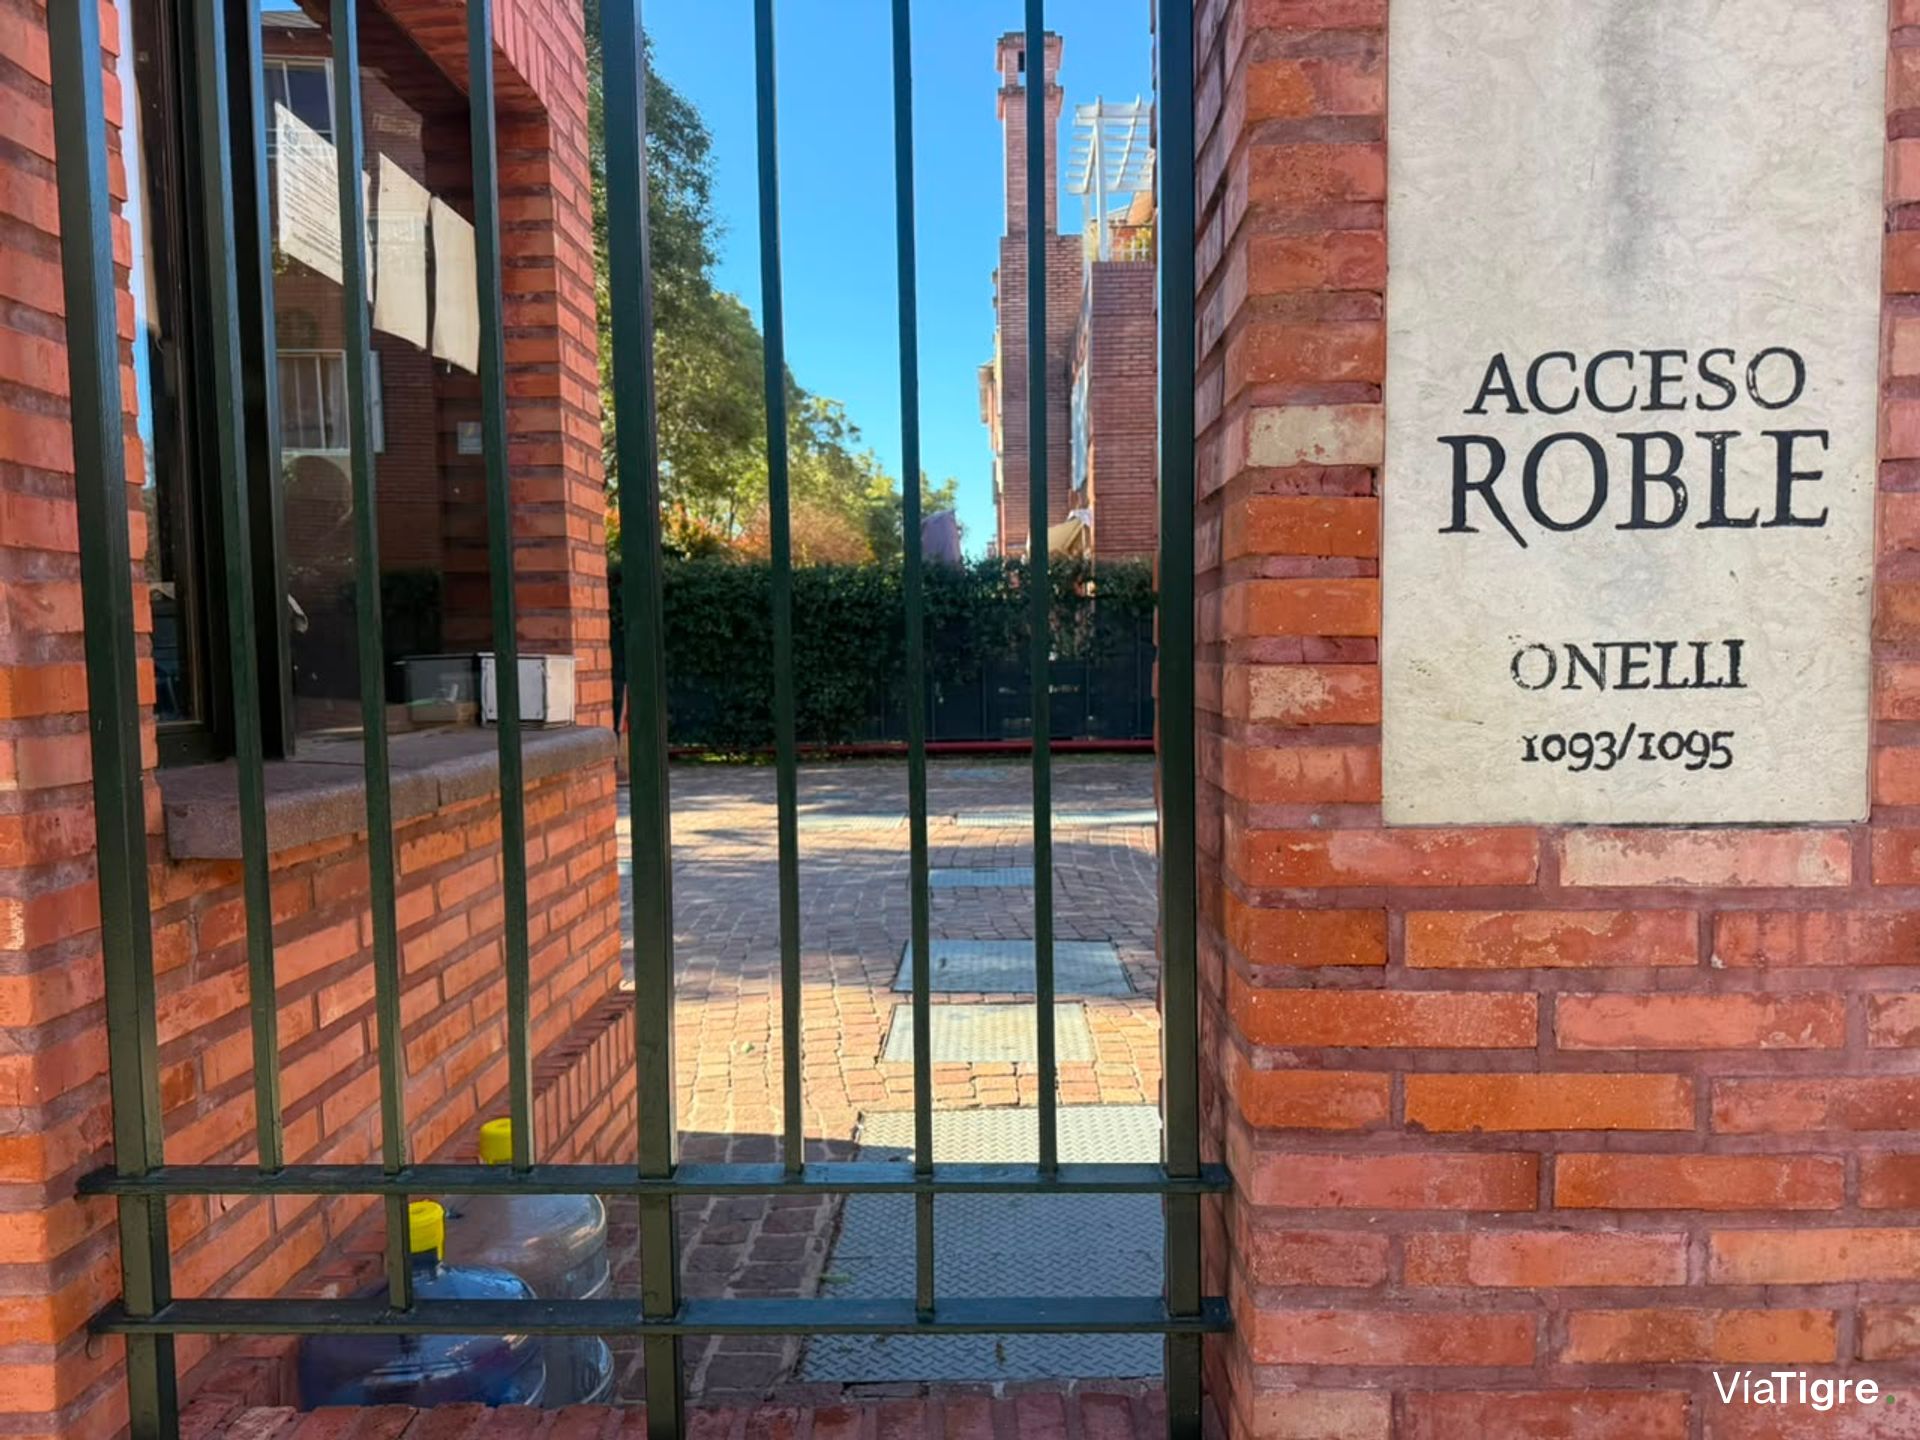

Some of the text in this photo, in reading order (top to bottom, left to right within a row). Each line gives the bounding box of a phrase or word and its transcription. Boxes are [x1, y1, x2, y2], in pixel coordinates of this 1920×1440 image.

[1463, 347, 1806, 414] ACCESO
[1437, 429, 1829, 548] ROBLE
[1510, 639, 1747, 691] ONELLI
[1520, 723, 1735, 771] 1093/1095
